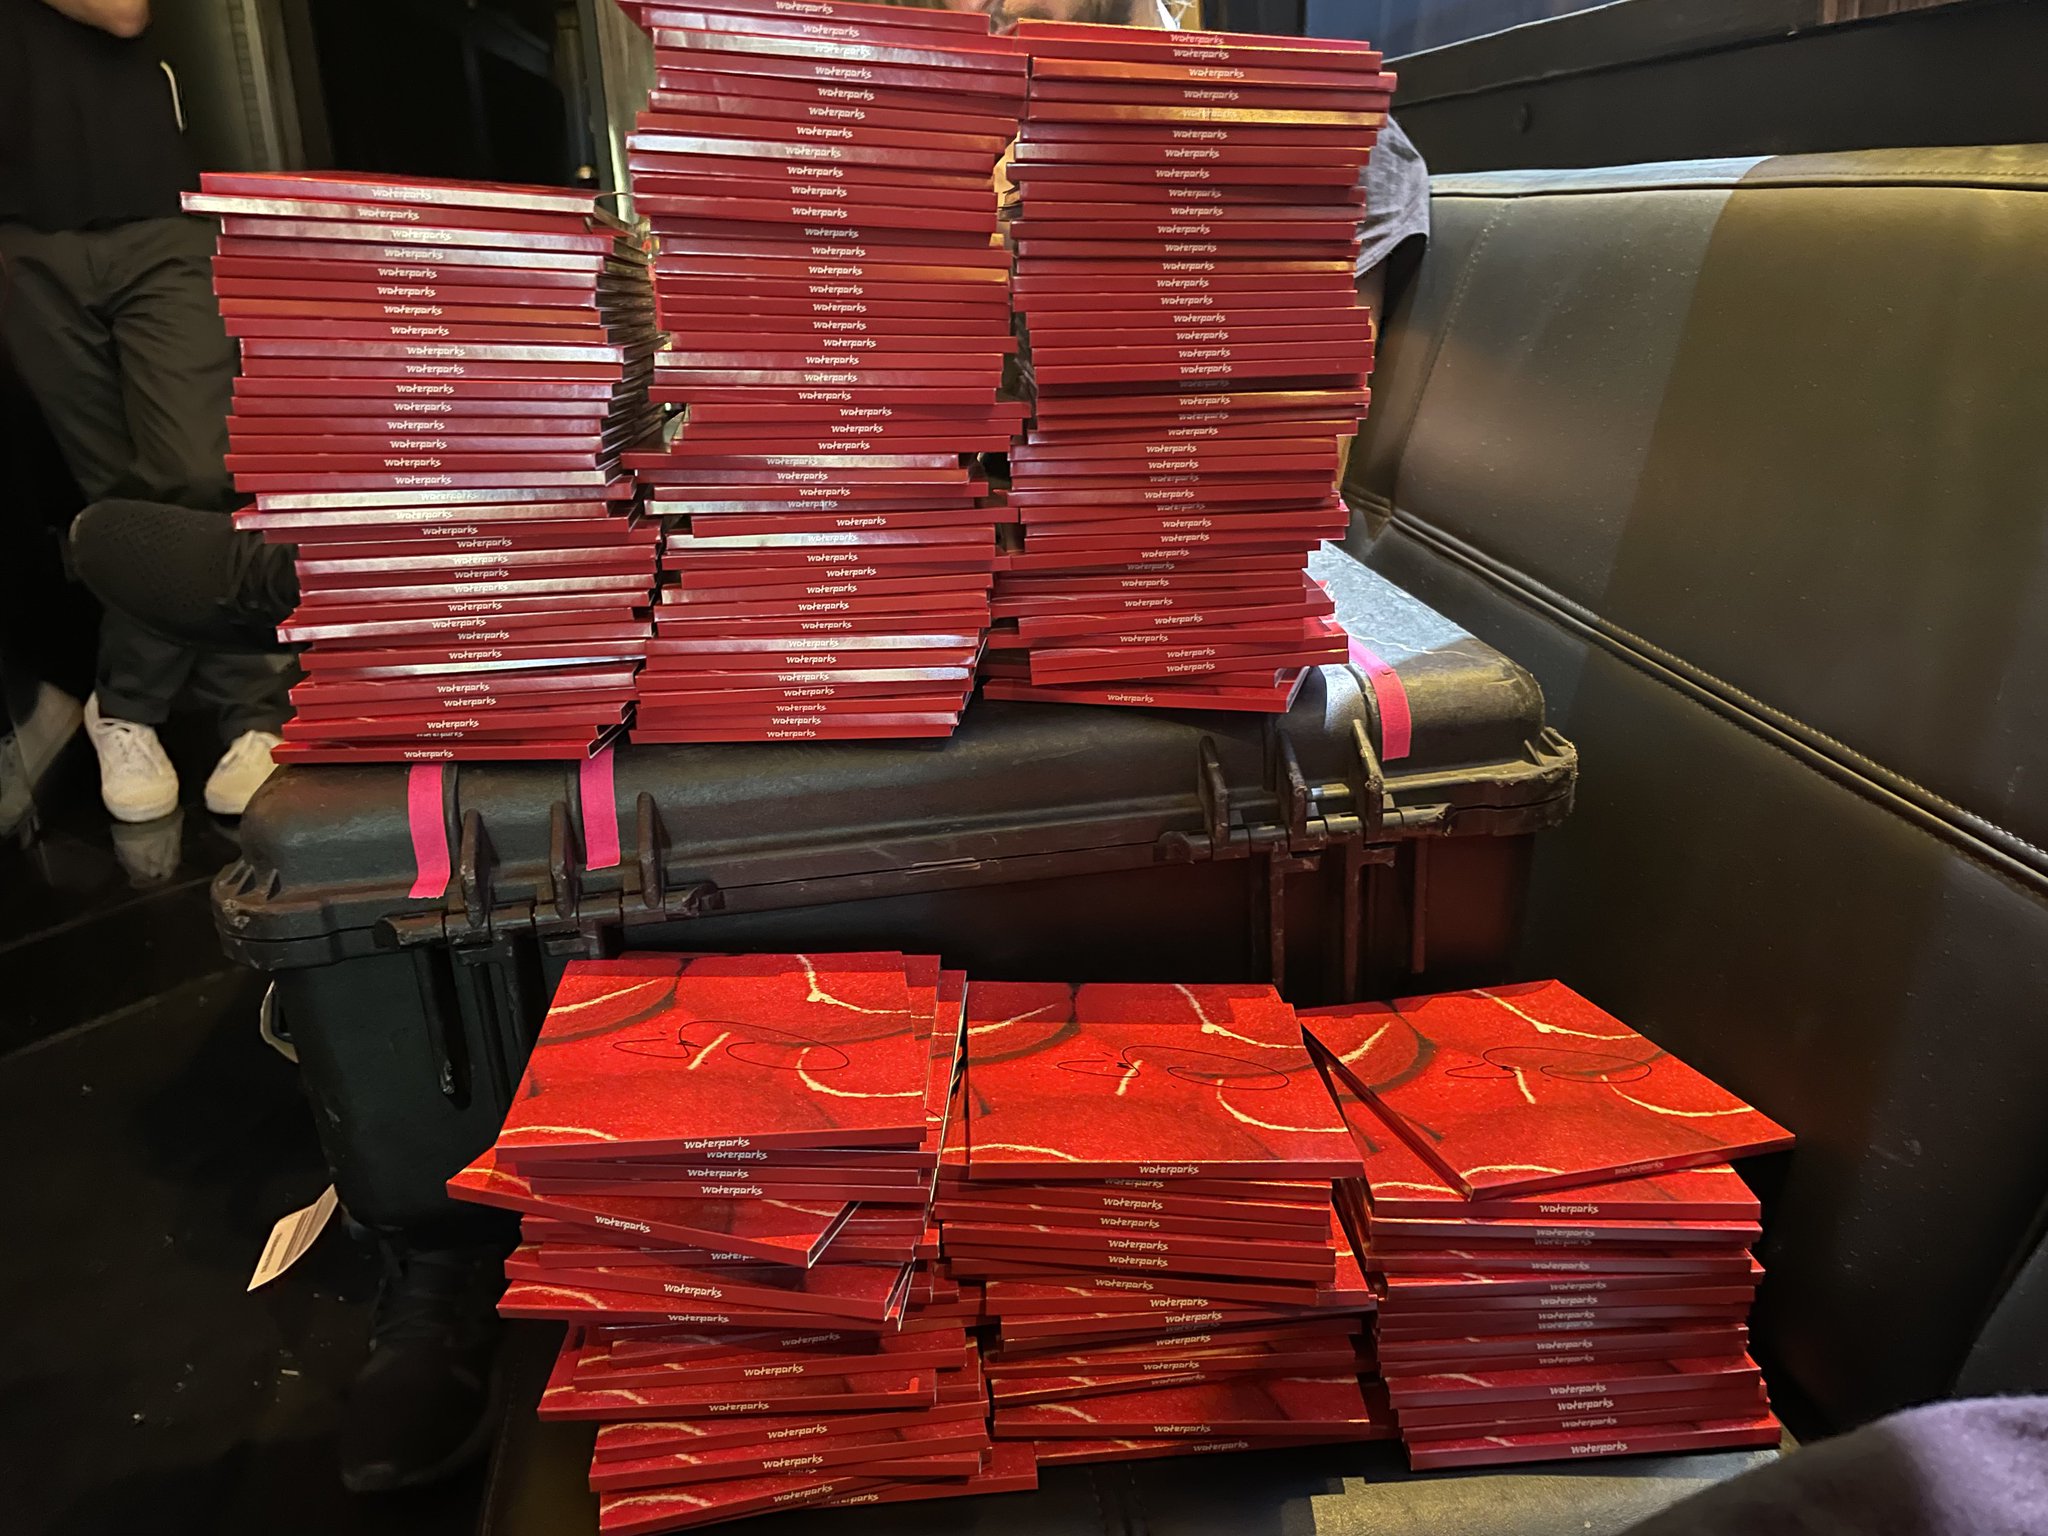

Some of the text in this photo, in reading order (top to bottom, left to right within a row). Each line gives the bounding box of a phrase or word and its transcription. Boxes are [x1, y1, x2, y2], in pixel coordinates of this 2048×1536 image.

[776, 1, 834, 13] waterparks
[802, 24, 860, 36] waterparks
[1170, 34, 1224, 45] waterparks
[815, 45, 872, 56] waterparks
[1173, 48, 1230, 59] waterparks
[815, 66, 872, 78] waterparks
[1189, 67, 1245, 78] waterparks
[818, 88, 875, 100] waterparks
[1184, 89, 1239, 100] waterparks
[808, 107, 865, 118] waterparks
[797, 126, 853, 138] waterparks
[1173, 129, 1228, 139] waterparks
[785, 146, 841, 157] waterparks
[1165, 148, 1220, 158] waterparks
[787, 166, 843, 178] waterparks
[1156, 168, 1210, 178] waterparks
[371, 188, 432, 201] waterparks
[791, 186, 847, 198] waterparks
[1169, 188, 1222, 198] waterparks
[358, 207, 420, 221] waterparks
[792, 206, 848, 218] waterparks
[1171, 206, 1224, 216] waterparks
[391, 228, 451, 241] waterparks
[804, 227, 859, 238] waterparks
[1157, 224, 1210, 234] waterparks
[811, 246, 866, 257] waterparks
[1165, 243, 1217, 252] waterparks
[384, 247, 444, 260] waterparks
[808, 265, 863, 276] waterparks
[1162, 261, 1215, 270] waterparks
[378, 267, 438, 280] waterparks
[1157, 278, 1209, 287] waterparks
[377, 285, 436, 298] waterparks
[809, 284, 863, 295] waterparks
[1161, 296, 1213, 305] waterparks
[384, 305, 442, 316] waterparks
[813, 303, 867, 313] waterparks
[1173, 313, 1226, 323] waterparks
[813, 320, 867, 330] waterparks
[390, 325, 450, 337] waterparks
[1176, 330, 1229, 340] waterparks
[823, 338, 876, 348] waterparks
[407, 345, 465, 357] waterparks
[1179, 348, 1231, 357] waterparks
[806, 355, 859, 365] waterparks
[406, 364, 464, 375] waterparks
[1180, 364, 1232, 373] waterparks
[804, 373, 858, 383] waterparks
[396, 383, 455, 395] waterparks
[798, 391, 852, 401] waterparks
[1179, 396, 1231, 405] waterparks
[394, 402, 451, 412] waterparks
[840, 407, 892, 416] waterparks
[387, 420, 445, 432] waterparks
[831, 424, 884, 433] waterparks
[1168, 426, 1218, 436] waterparks
[389, 439, 447, 450] waterparks
[818, 441, 870, 450] waterparks
[1146, 444, 1197, 453] waterparks
[384, 457, 441, 468] waterparks
[767, 457, 819, 465] waterparks
[1148, 460, 1199, 468] waterparks
[394, 475, 452, 486] waterparks
[777, 471, 828, 480] waterparks
[799, 487, 851, 496] waterparks
[1144, 489, 1195, 498] waterparks
[788, 500, 838, 509] waterparks
[396, 509, 453, 520] waterparks
[836, 516, 886, 527] waterparks
[1162, 518, 1212, 527] waterparks
[422, 525, 478, 536] waterparks
[808, 533, 858, 543] waterparks
[1161, 533, 1210, 542] waterparks
[457, 538, 513, 549] waterparks
[806, 553, 858, 563] waterparks
[1141, 548, 1190, 557] waterparks
[454, 554, 509, 565] waterparks
[1127, 562, 1175, 570] waterparks
[454, 568, 509, 579] waterparks
[826, 567, 877, 578] waterparks
[454, 582, 509, 593] waterparks
[1121, 578, 1169, 587] waterparks
[806, 584, 857, 594] waterparks
[448, 601, 503, 612] waterparks
[798, 601, 849, 612] waterparks
[1124, 597, 1173, 607] waterparks
[432, 617, 486, 628] waterparks
[1154, 614, 1203, 624] waterparks
[801, 620, 852, 630] waterparks
[458, 630, 510, 641] waterparks
[1120, 634, 1169, 643] waterparks
[788, 638, 839, 648] waterparks
[448, 649, 502, 660] waterparks
[1166, 648, 1216, 658] waterparks
[786, 655, 837, 665] waterparks
[1166, 662, 1216, 671] waterparks
[778, 672, 829, 682] waterparks
[437, 682, 490, 694] waterparks
[784, 687, 835, 697] waterparks
[443, 697, 497, 708] waterparks
[1107, 694, 1154, 702] waterparks
[776, 703, 827, 713] waterparks
[427, 718, 479, 730] waterparks
[772, 716, 821, 725] waterparks
[767, 729, 816, 739] waterparks
[404, 749, 454, 760] waterparks
[683, 1137, 751, 1149] waterparks
[706, 1150, 768, 1160] waterparks
[687, 1168, 750, 1179] waterparks
[1139, 1163, 1200, 1176] waterparks
[1104, 1177, 1164, 1189] waterparks
[701, 1185, 763, 1196] waterparks
[1103, 1197, 1164, 1210] waterparks
[1539, 1203, 1600, 1214] waterparks
[594, 1215, 651, 1232] waterparks
[1100, 1216, 1160, 1229] waterparks
[1536, 1228, 1596, 1238] waterparks
[1108, 1239, 1169, 1252] waterparks
[1108, 1255, 1169, 1267] waterparks
[1531, 1260, 1590, 1271] waterparks
[663, 1283, 722, 1296] waterparks
[1095, 1278, 1154, 1290] waterparks
[1550, 1280, 1607, 1291] waterparks
[1150, 1297, 1209, 1308] waterparks
[1540, 1295, 1598, 1306] waterparks
[668, 1313, 730, 1324] waterparks
[1165, 1312, 1223, 1324] waterparks
[1538, 1311, 1595, 1320] waterparks
[780, 1331, 841, 1347] waterparks
[1156, 1334, 1212, 1346] waterparks
[1537, 1340, 1593, 1350] waterparks
[1539, 1354, 1595, 1364] waterparks
[743, 1364, 804, 1378] waterparks
[1143, 1361, 1200, 1371] waterparks
[1550, 1383, 1607, 1395] waterparks
[708, 1402, 770, 1413] waterparks
[1557, 1399, 1614, 1411] waterparks
[1561, 1416, 1617, 1428] waterparks
[767, 1425, 828, 1440] waterparks
[1154, 1424, 1212, 1434] waterparks
[1193, 1440, 1249, 1451] waterparks
[1571, 1442, 1628, 1454] waterparks
[762, 1454, 824, 1470] waterparks
[773, 1484, 833, 1502] waterparks
